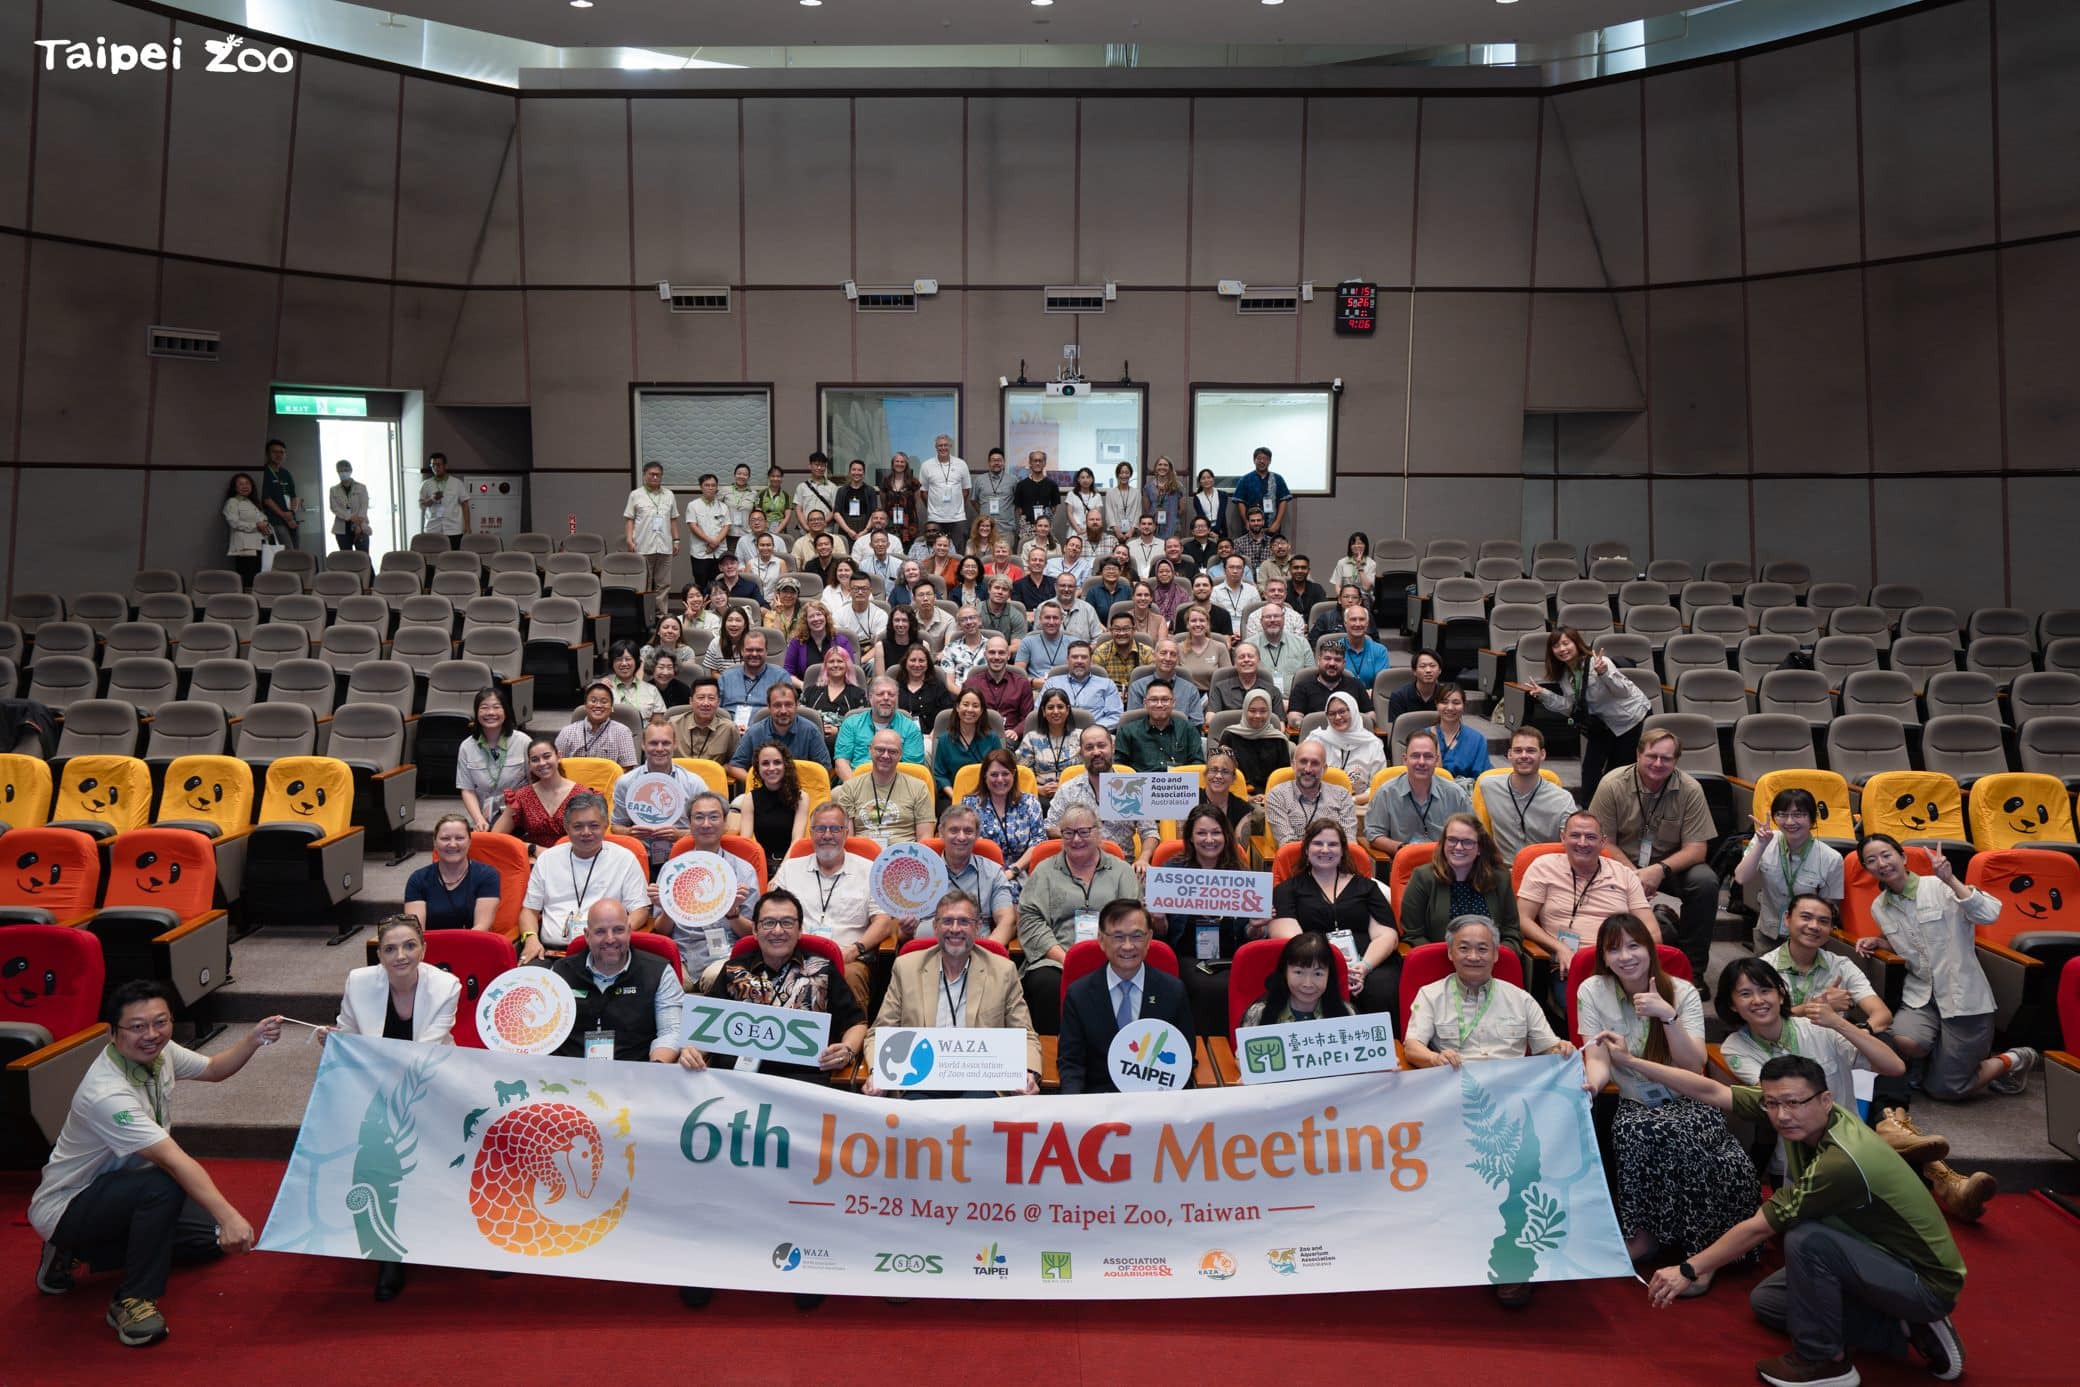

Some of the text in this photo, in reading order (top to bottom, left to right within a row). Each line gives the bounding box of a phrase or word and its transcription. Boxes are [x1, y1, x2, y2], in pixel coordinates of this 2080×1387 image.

[285, 405, 309, 413] EXIT
[627, 801, 653, 814] EAZA
[1154, 872, 1256, 888] ASSOCIATION
[1177, 885, 1197, 897] OF
[1200, 886, 1241, 900] ZOOS
[1152, 896, 1240, 912] AQUARIUMS
[687, 1005, 820, 1057] ZOOS
[733, 1022, 776, 1041] SEA
[1288, 1025, 1387, 1052] 臺北市立動物園
[938, 1040, 989, 1053] WAZA
[938, 1061, 1004, 1069] World Association
[1292, 1048, 1349, 1069] TAIPEI
[938, 1070, 1023, 1080] of Zoos and Aquariums
[1120, 1059, 1176, 1087] TAIPEI
[679, 1096, 1429, 1192] 6th Joint TAG Meeting
[844, 1195, 1261, 1230] 25-28 May 2026 @ Taipei Zoo, Taiwan
[803, 1248, 830, 1257] WAZA
[873, 1252, 944, 1274] ZOOS
[897, 1259, 920, 1269] SEA
[1103, 1257, 1167, 1265] ASSOCIATION
[972, 1266, 1009, 1276] TAIPEI
